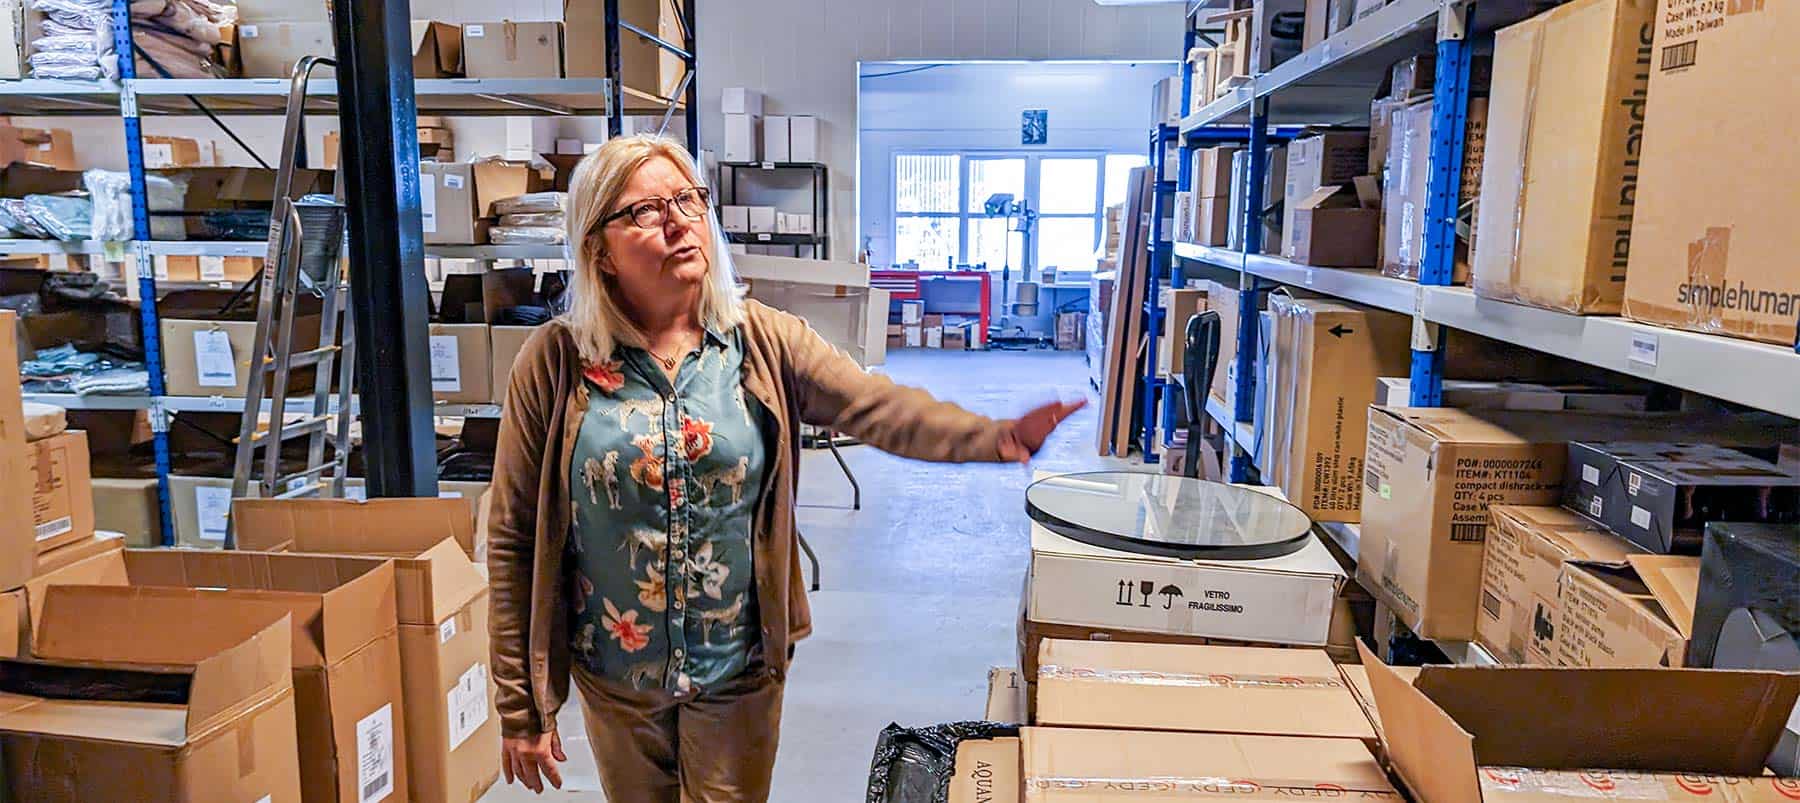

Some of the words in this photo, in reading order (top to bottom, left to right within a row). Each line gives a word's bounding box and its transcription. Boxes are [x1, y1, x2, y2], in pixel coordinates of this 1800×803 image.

[1665, 11, 1684, 24] Case
[1665, 27, 1685, 40] Made
[1696, 17, 1724, 33] Taiwan
[1336, 396, 1344, 420] plastic
[1455, 482, 1496, 490] compact
[1499, 482, 1540, 490] dishrack
[1454, 491, 1477, 500] QTY:
[1487, 494, 1504, 502] pcs
[1453, 502, 1476, 511] Case
[1204, 589, 1231, 600] VETRO
[1188, 601, 1243, 613] FRAGILISSIMO
